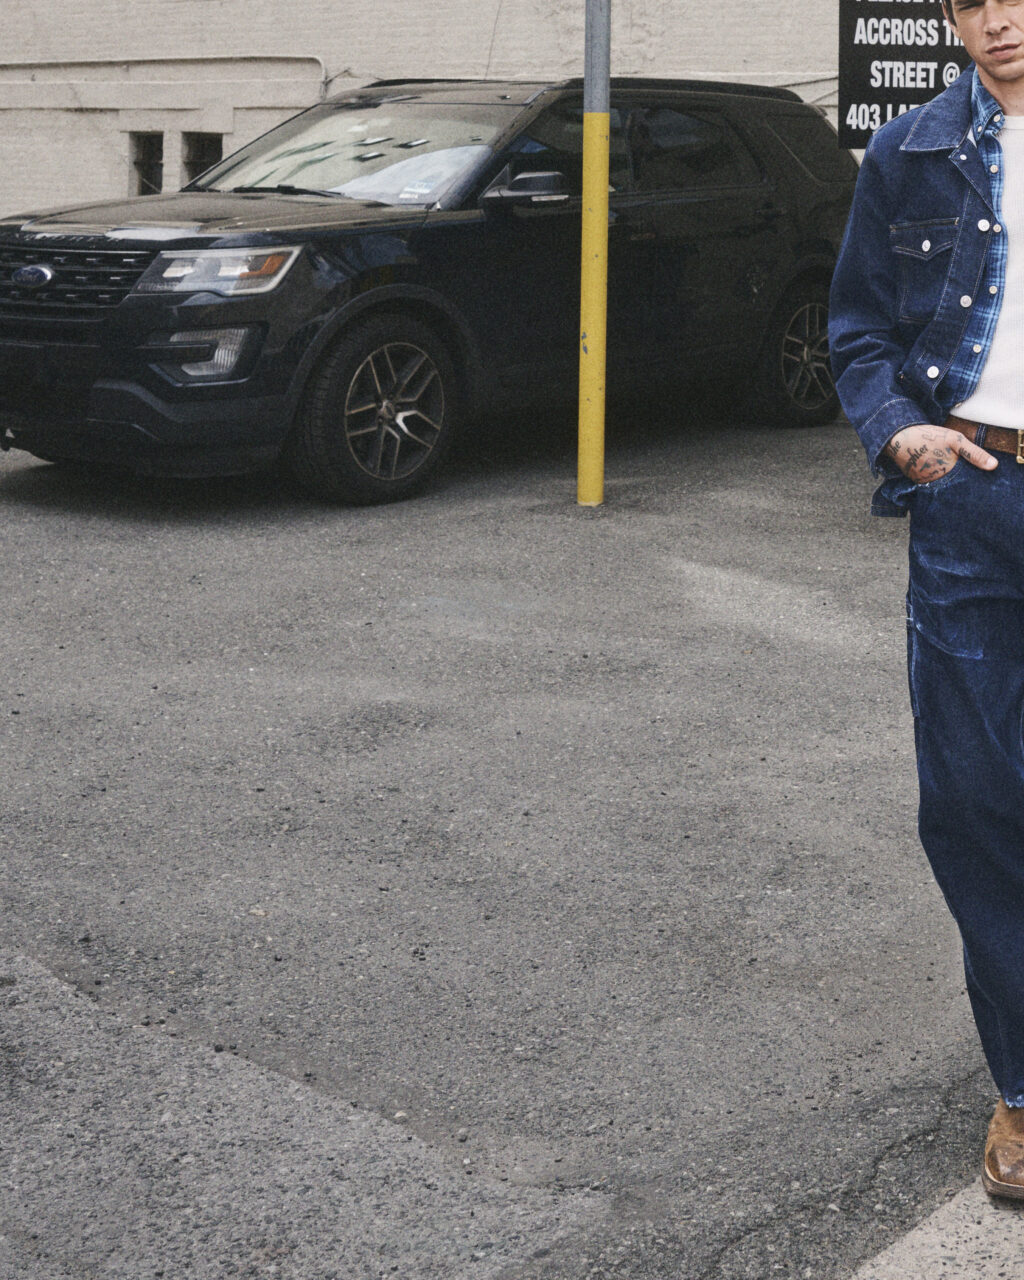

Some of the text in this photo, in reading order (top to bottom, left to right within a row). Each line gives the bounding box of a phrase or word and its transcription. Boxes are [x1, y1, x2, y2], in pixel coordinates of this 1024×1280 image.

[854, 18, 939, 46] ACCROSS
[870, 61, 938, 88] STREET
[846, 104, 881, 130] 403
